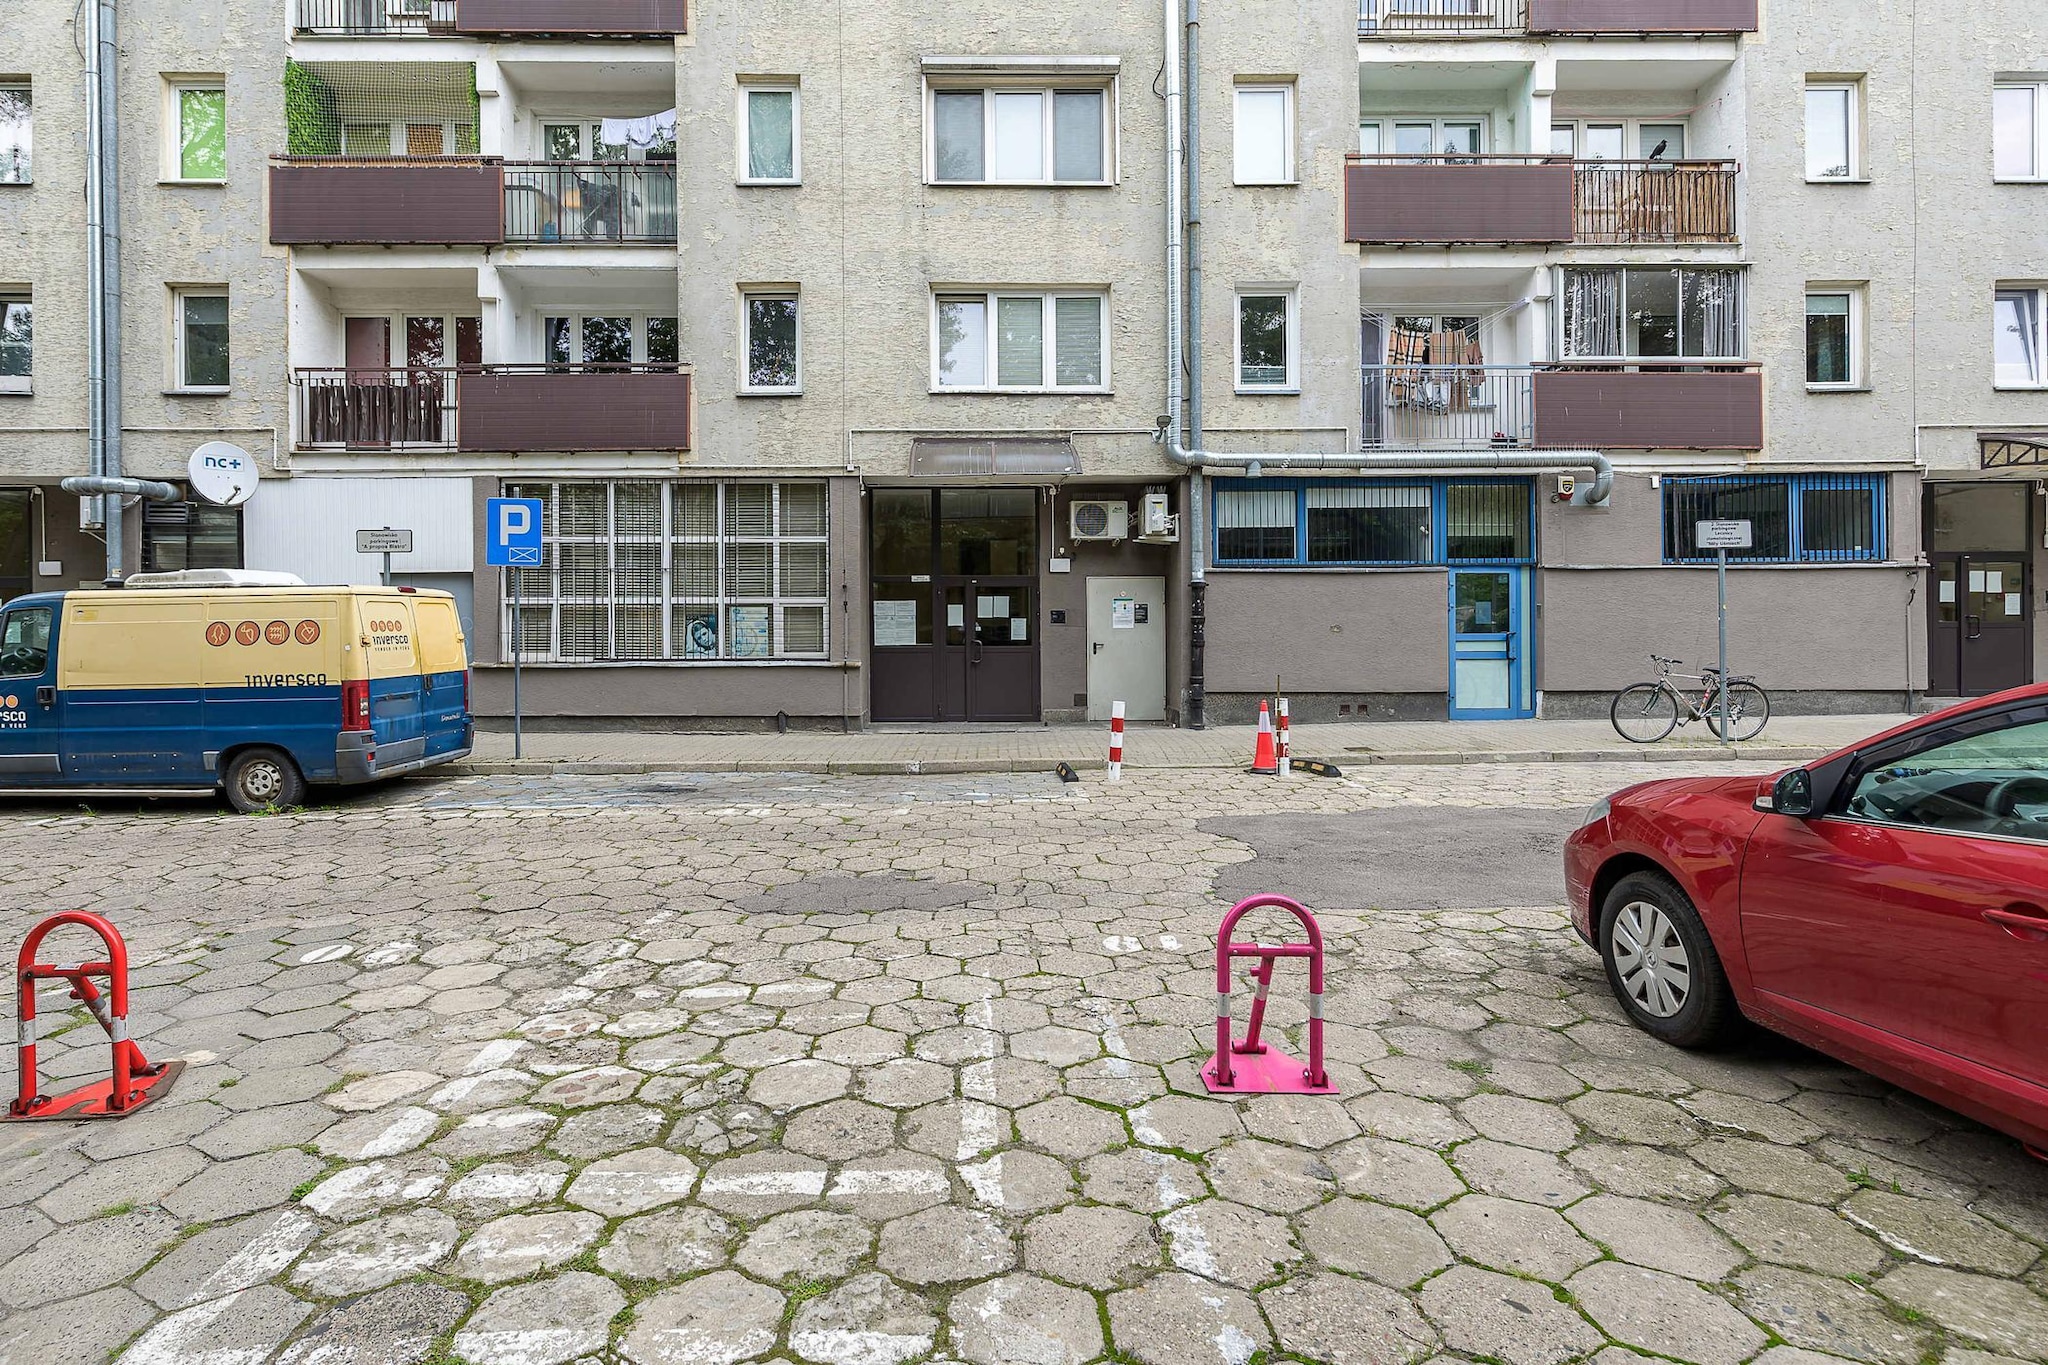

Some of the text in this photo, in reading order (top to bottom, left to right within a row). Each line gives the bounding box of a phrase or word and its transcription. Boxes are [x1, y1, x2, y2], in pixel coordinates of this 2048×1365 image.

[206, 457, 241, 469] nc+
[500, 505, 530, 546] P
[372, 635, 409, 645] inversco
[245, 673, 326, 688] inversco
[0, 711, 26, 721] sco
